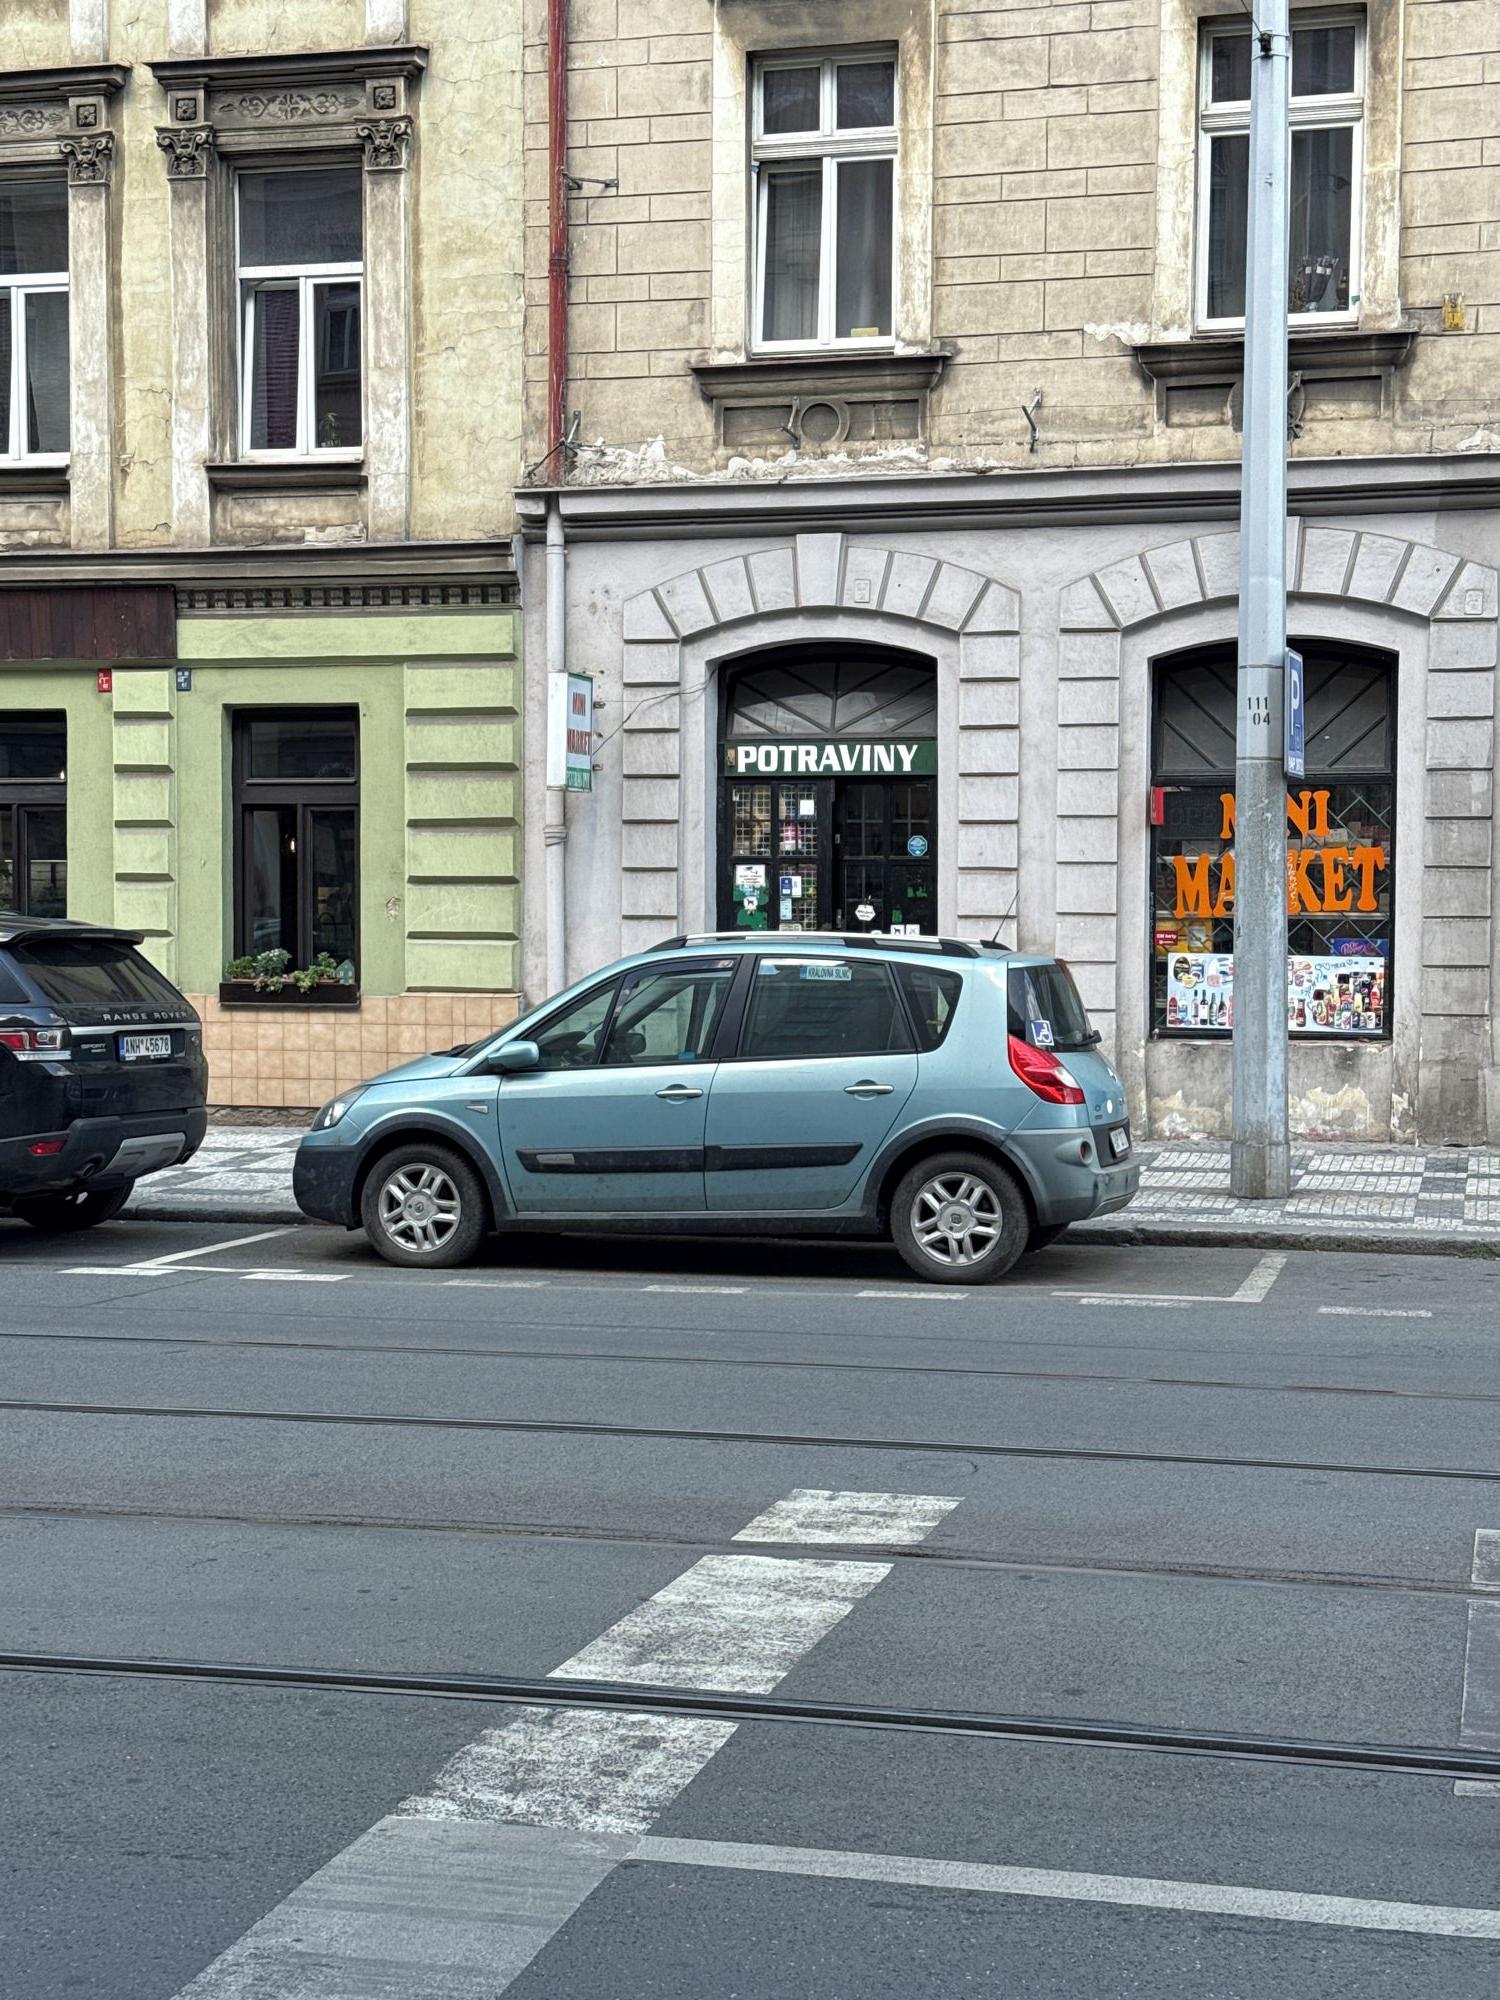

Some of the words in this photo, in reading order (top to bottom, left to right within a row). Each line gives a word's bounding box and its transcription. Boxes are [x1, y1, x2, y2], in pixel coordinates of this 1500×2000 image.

[1248, 696, 1268, 710] 111
[1290, 668, 1300, 736] P
[1252, 712, 1271, 726] 04
[737, 744, 918, 773] POTRAVINY
[1220, 790, 1331, 839] MNI
[1173, 846, 1385, 919] MAKET
[103, 1012, 148, 1021] RANGE
[154, 1011, 187, 1019] ROVER
